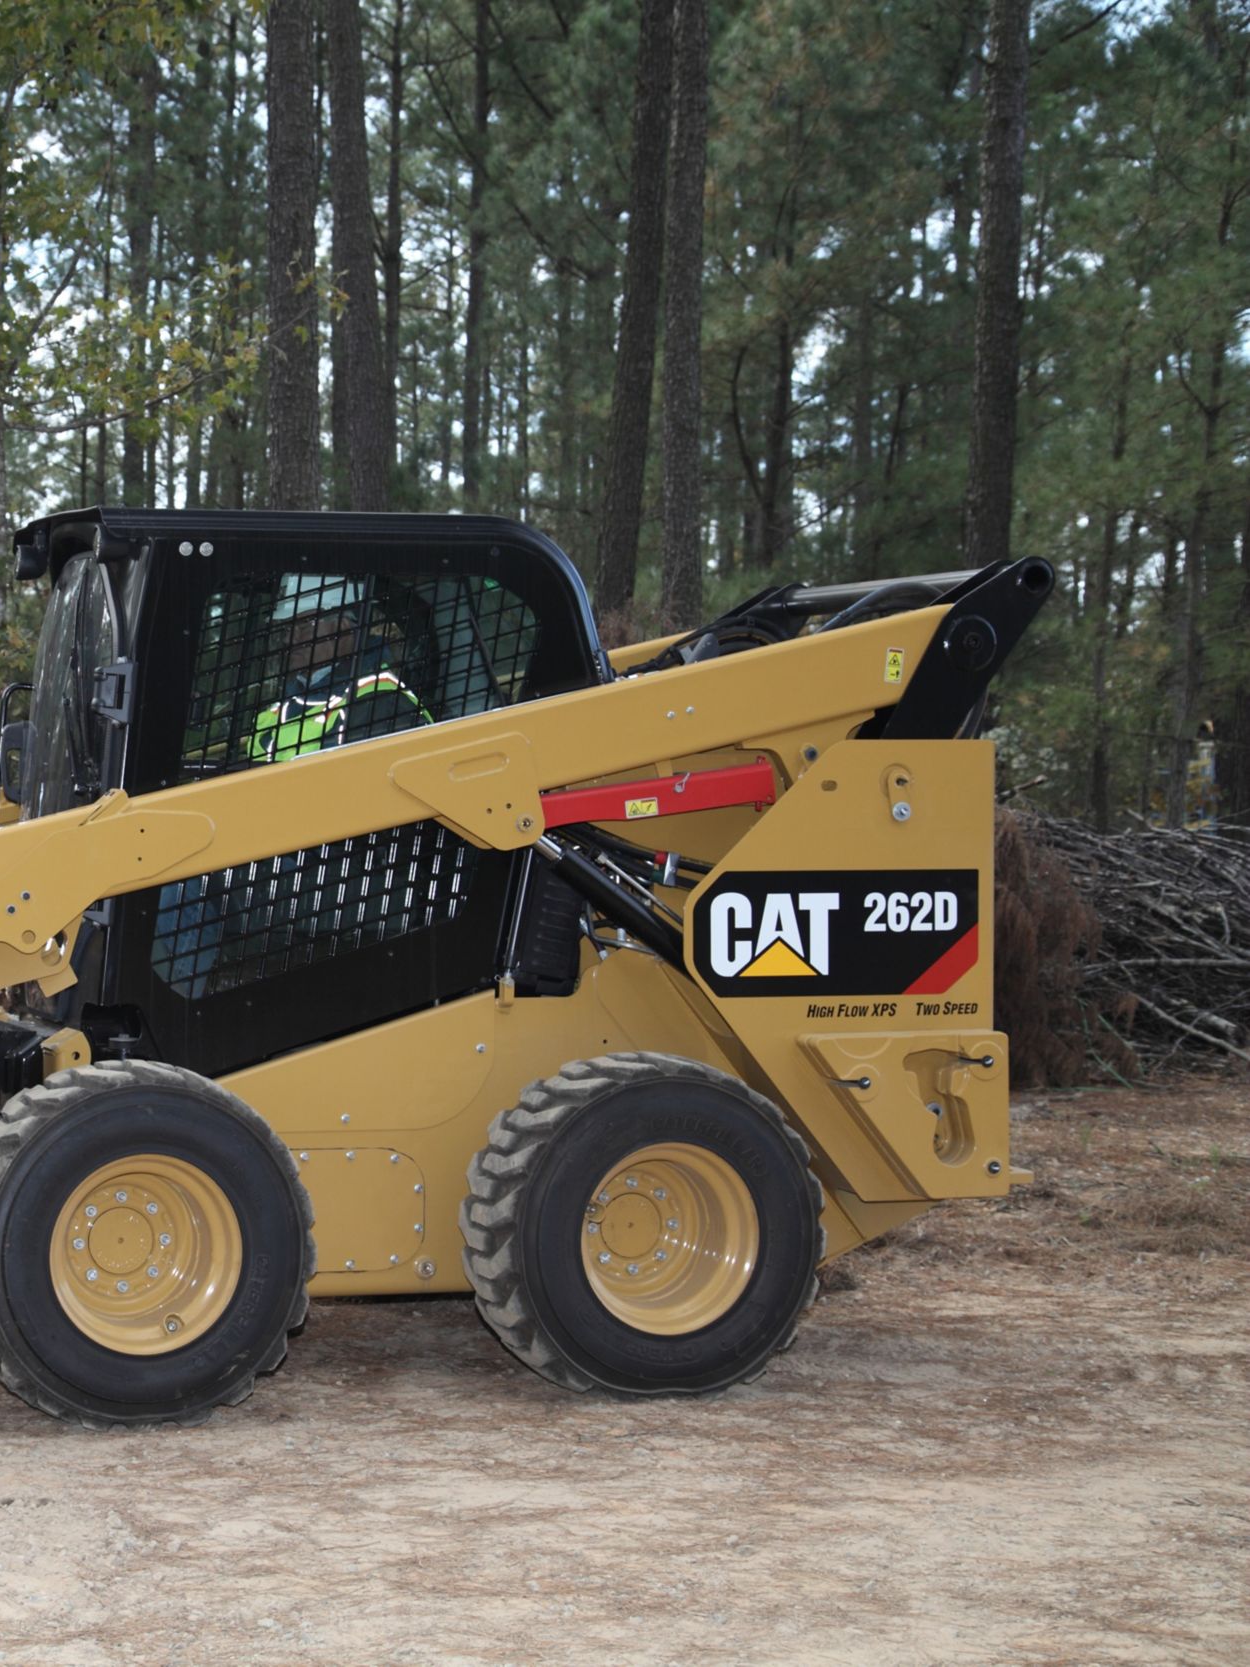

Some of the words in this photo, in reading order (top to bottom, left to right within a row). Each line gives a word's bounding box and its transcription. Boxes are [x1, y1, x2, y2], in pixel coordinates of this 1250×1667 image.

[863, 891, 958, 932] 262D
[710, 892, 840, 977] CAT
[806, 1004, 835, 1018] HIGH
[837, 1003, 869, 1017] FLOW
[871, 1003, 898, 1017] XPS
[916, 1002, 941, 1016] TWO
[943, 1001, 979, 1016] SPEED
